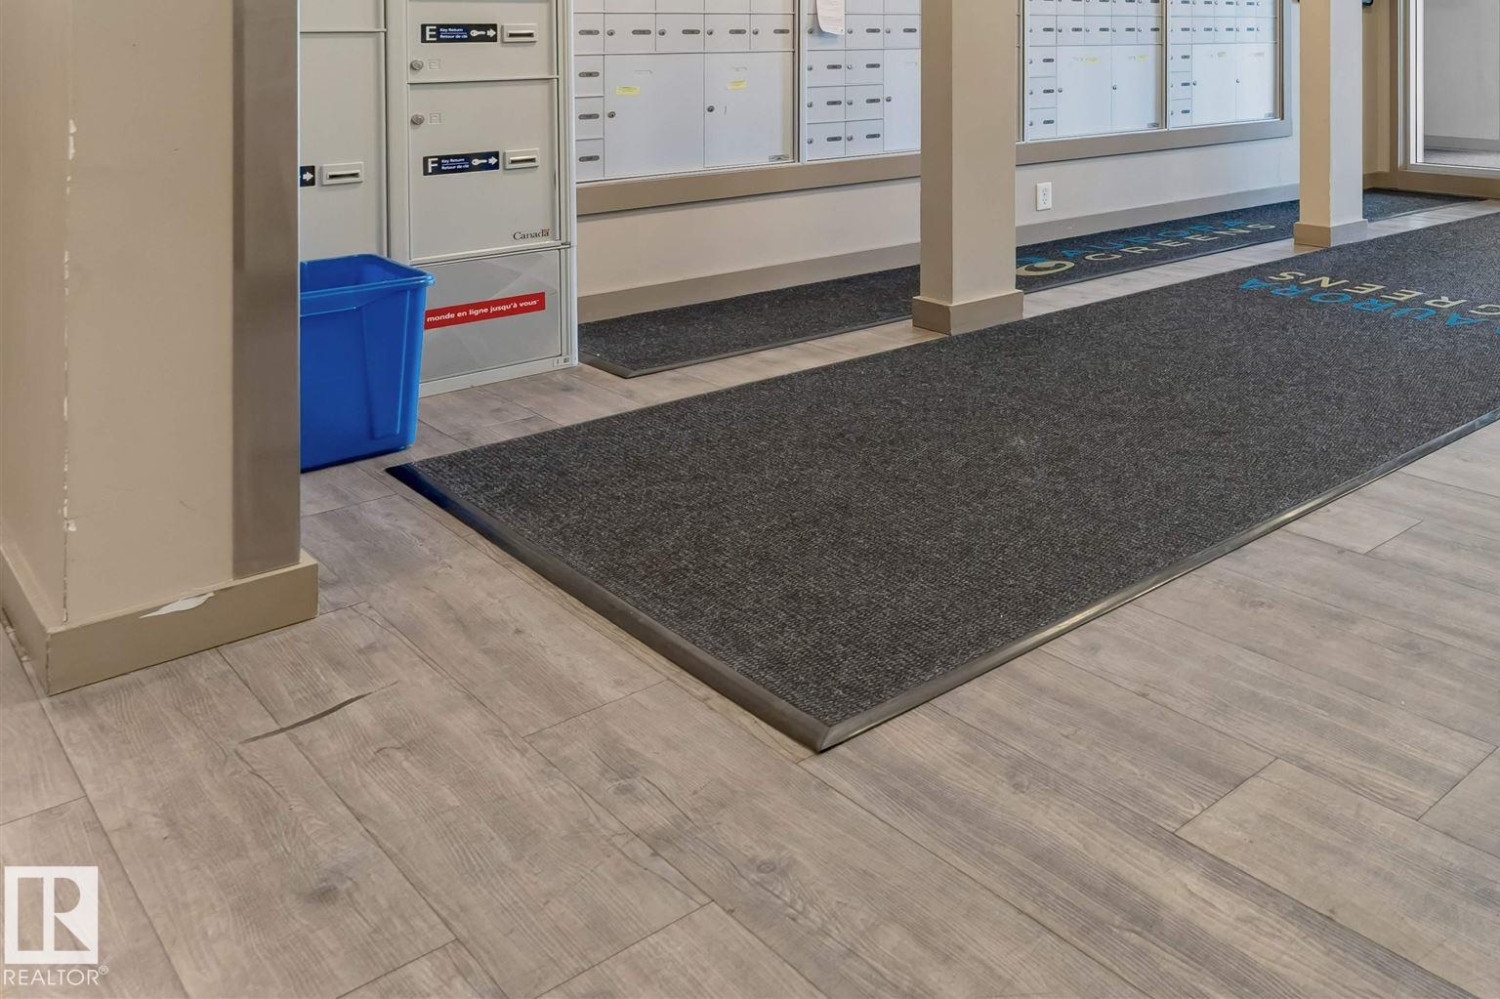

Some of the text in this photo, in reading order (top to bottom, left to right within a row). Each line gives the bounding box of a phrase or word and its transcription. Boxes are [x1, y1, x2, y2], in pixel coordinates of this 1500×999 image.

[425, 26, 437, 41] E
[428, 158, 438, 173] F
[513, 229, 550, 240] Canada
[1060, 220, 1249, 258] AURORA
[1084, 224, 1276, 261] GREENS
[1239, 278, 1491, 327] AURORA
[426, 313, 455, 323] monde
[469, 307, 489, 316] ligne
[490, 303, 518, 313] jusqu'à
